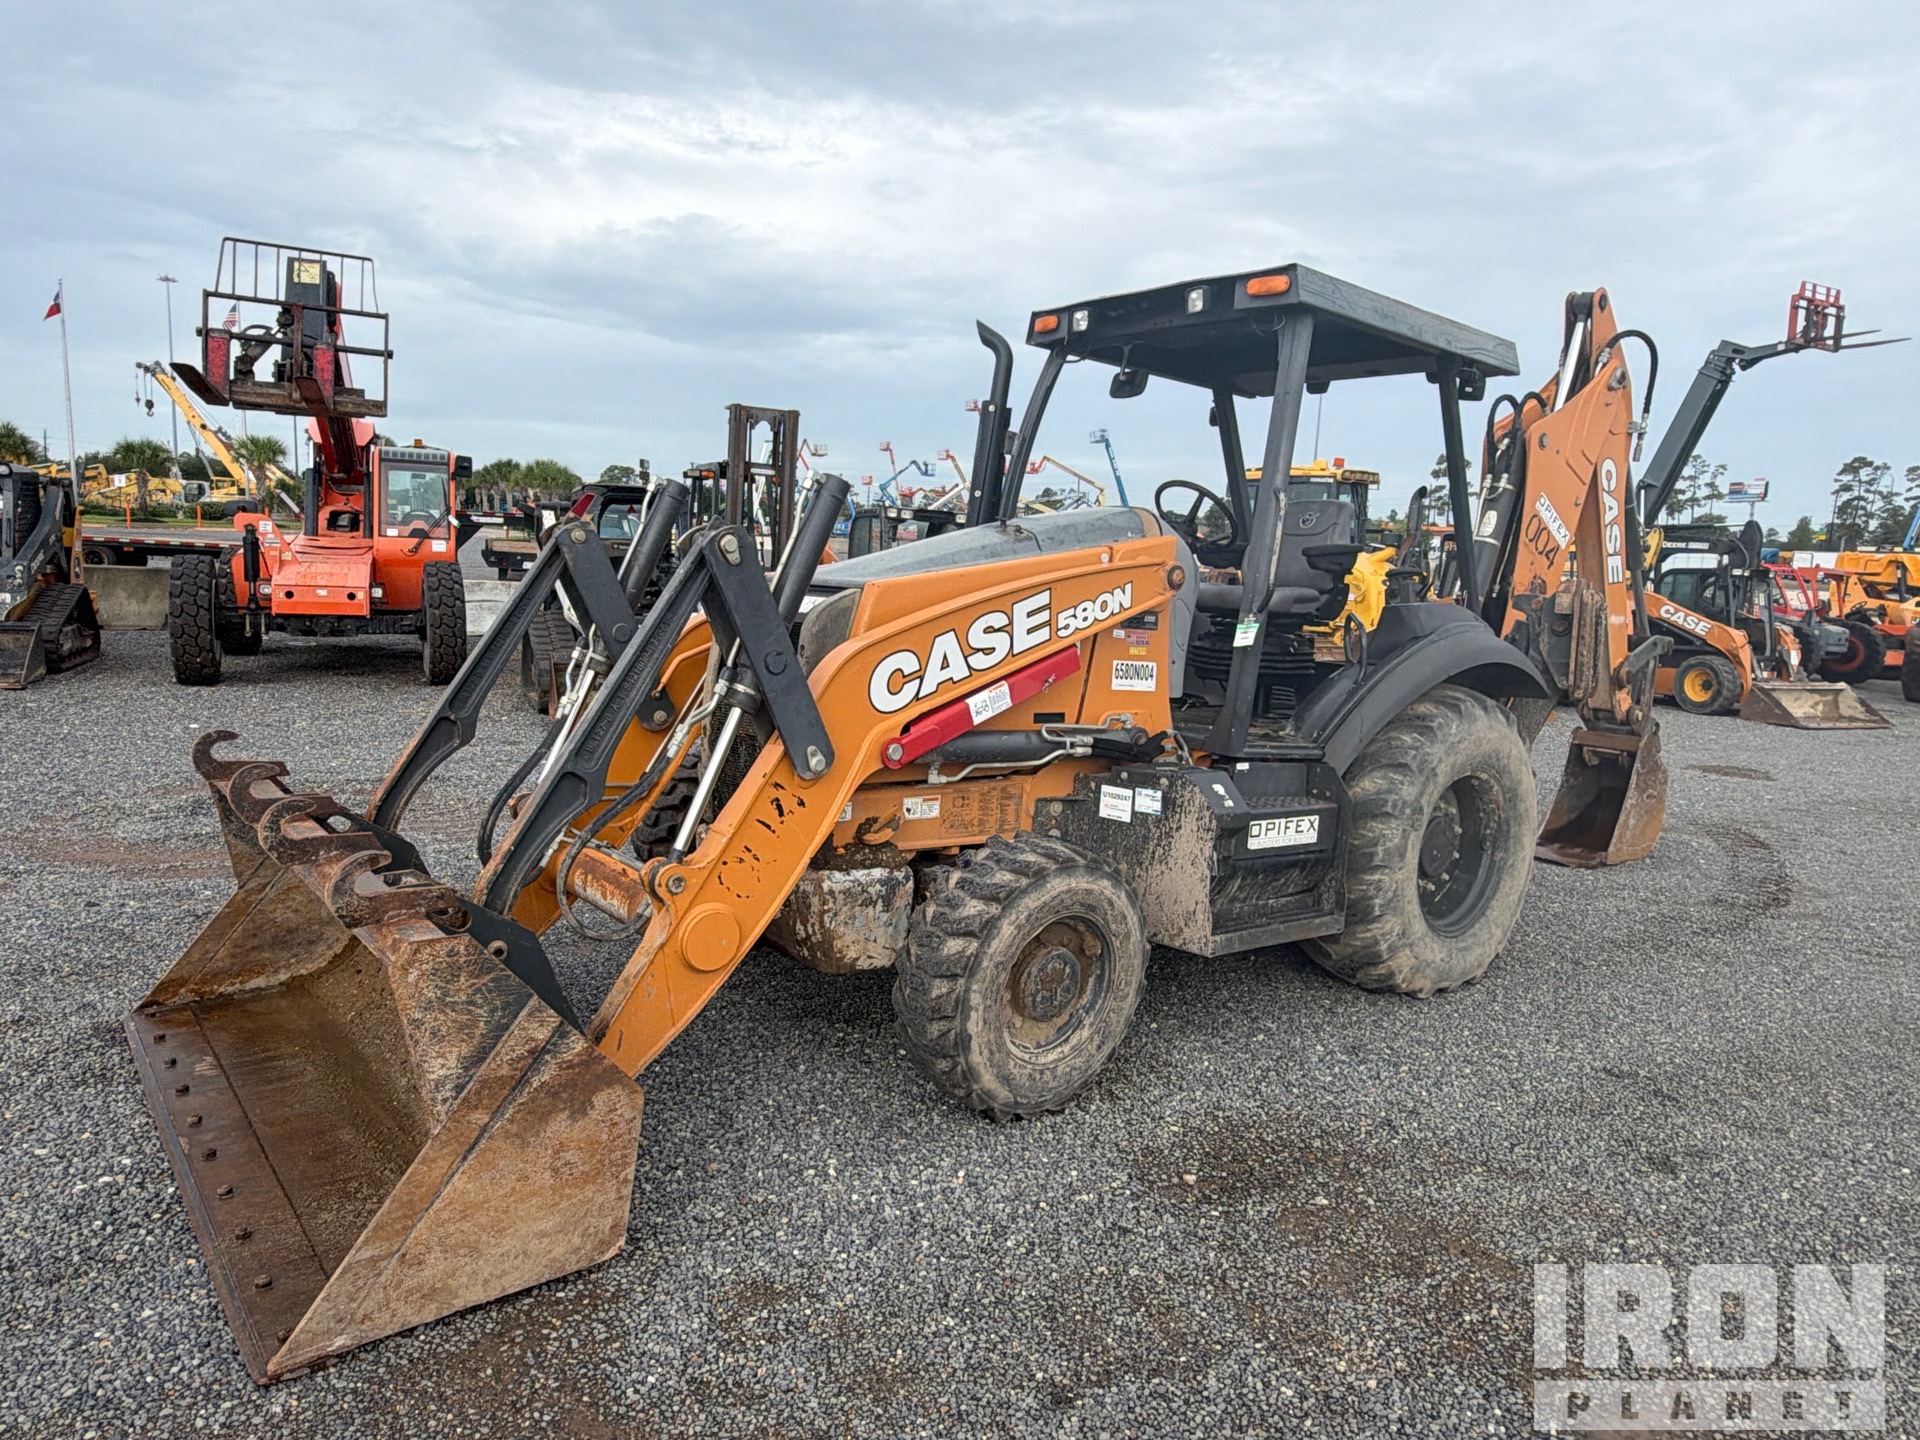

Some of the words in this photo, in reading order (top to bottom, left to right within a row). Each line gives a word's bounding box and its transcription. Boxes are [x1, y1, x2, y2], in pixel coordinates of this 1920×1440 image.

[1538, 494, 1569, 541] OPIFEX
[1601, 458, 1623, 585] CASE
[1525, 513, 1561, 570] 004
[1659, 604, 1712, 636] CASE
[869, 588, 1051, 713] CASE
[1055, 581, 1133, 638] 580N
[1114, 662, 1154, 682] 6580N004
[1102, 790, 1131, 802] U1029247
[1250, 817, 1317, 838] OPIFEX
